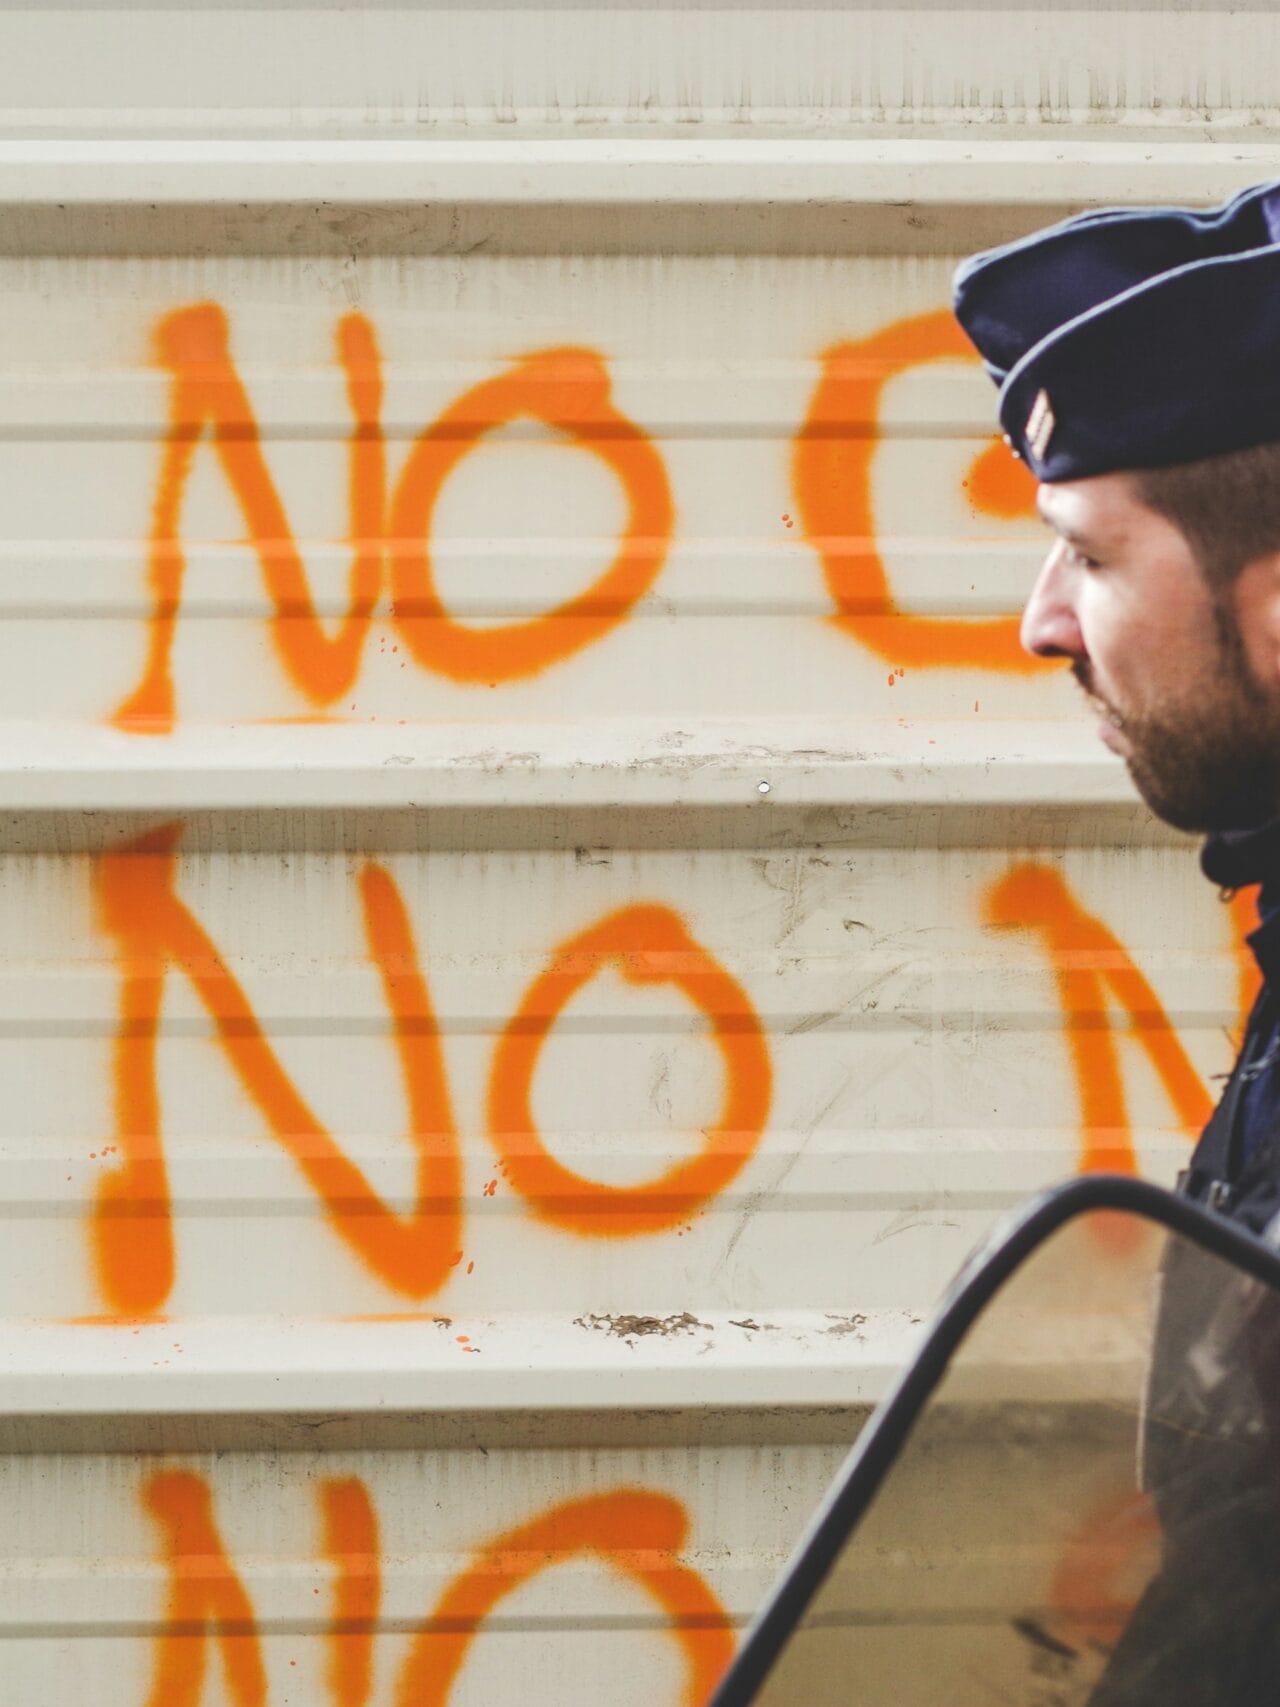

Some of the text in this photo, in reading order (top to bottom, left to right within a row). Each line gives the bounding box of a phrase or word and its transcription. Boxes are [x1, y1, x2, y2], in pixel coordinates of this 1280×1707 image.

[110, 299, 677, 735] NO
[88, 818, 775, 1325] NO
[137, 1463, 736, 1707] NO
